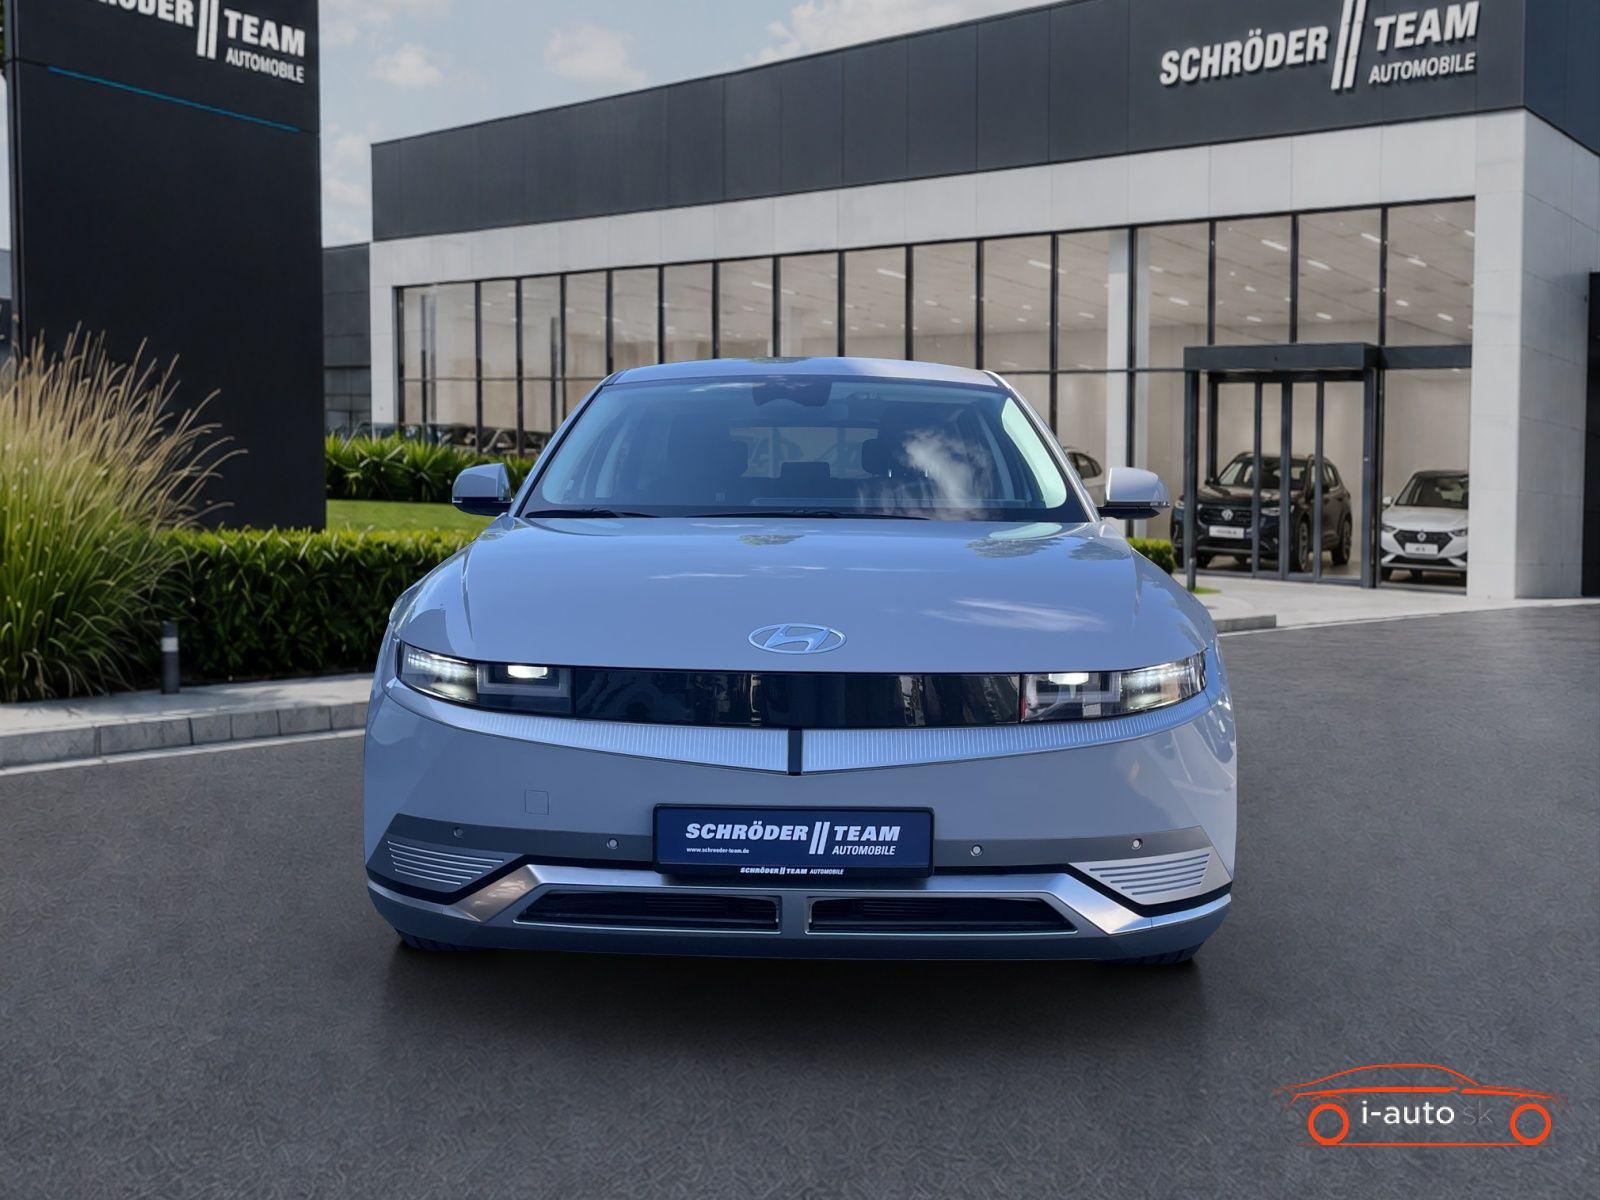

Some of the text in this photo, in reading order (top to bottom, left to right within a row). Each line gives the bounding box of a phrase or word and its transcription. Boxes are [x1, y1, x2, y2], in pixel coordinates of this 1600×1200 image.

[223, 8, 306, 57] TEAM
[1159, 1, 1480, 85] SCHRÖDER TEAM
[225, 47, 305, 84] AUTOMOBILE
[1368, 52, 1476, 84] AUTOMOBILE
[685, 820, 901, 842] SCHRÖDER TEAM
[686, 846, 750, 854] www.schroeder-team.de
[832, 845, 897, 856] AUTOMOBILE
[740, 866, 779, 874] SCHRÖDER
